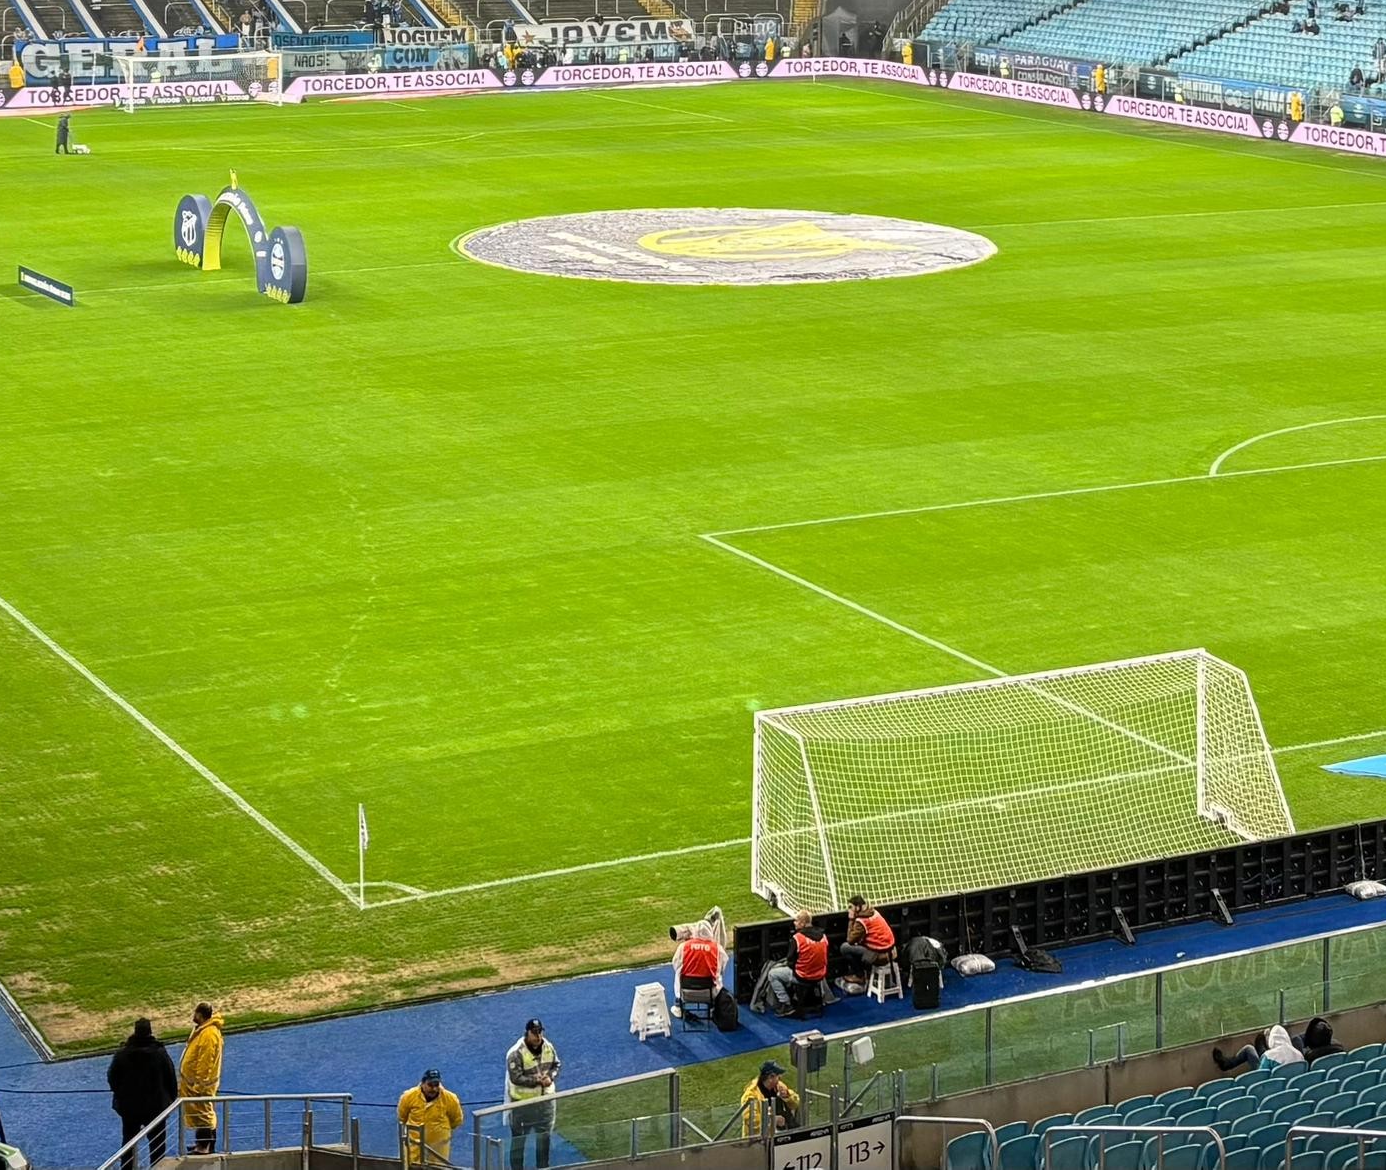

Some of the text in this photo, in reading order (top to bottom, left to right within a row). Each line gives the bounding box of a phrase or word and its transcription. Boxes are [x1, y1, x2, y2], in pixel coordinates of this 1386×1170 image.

[393, 48, 430, 64] COM
[1013, 54, 1071, 72] PARAGUAY
[553, 63, 722, 82] TORCEDOR, TE ASSOCIA!
[785, 60, 919, 80] TORCEDOR, TE ASSOCIA!
[303, 72, 485, 92] TORCEDOR, TE ASSOCIA!
[1116, 99, 1248, 131] TORCEDOR, TE ASSOCIA!
[1304, 127, 1378, 156] TORCEDOR,
[845, 1140, 870, 1165] 113
